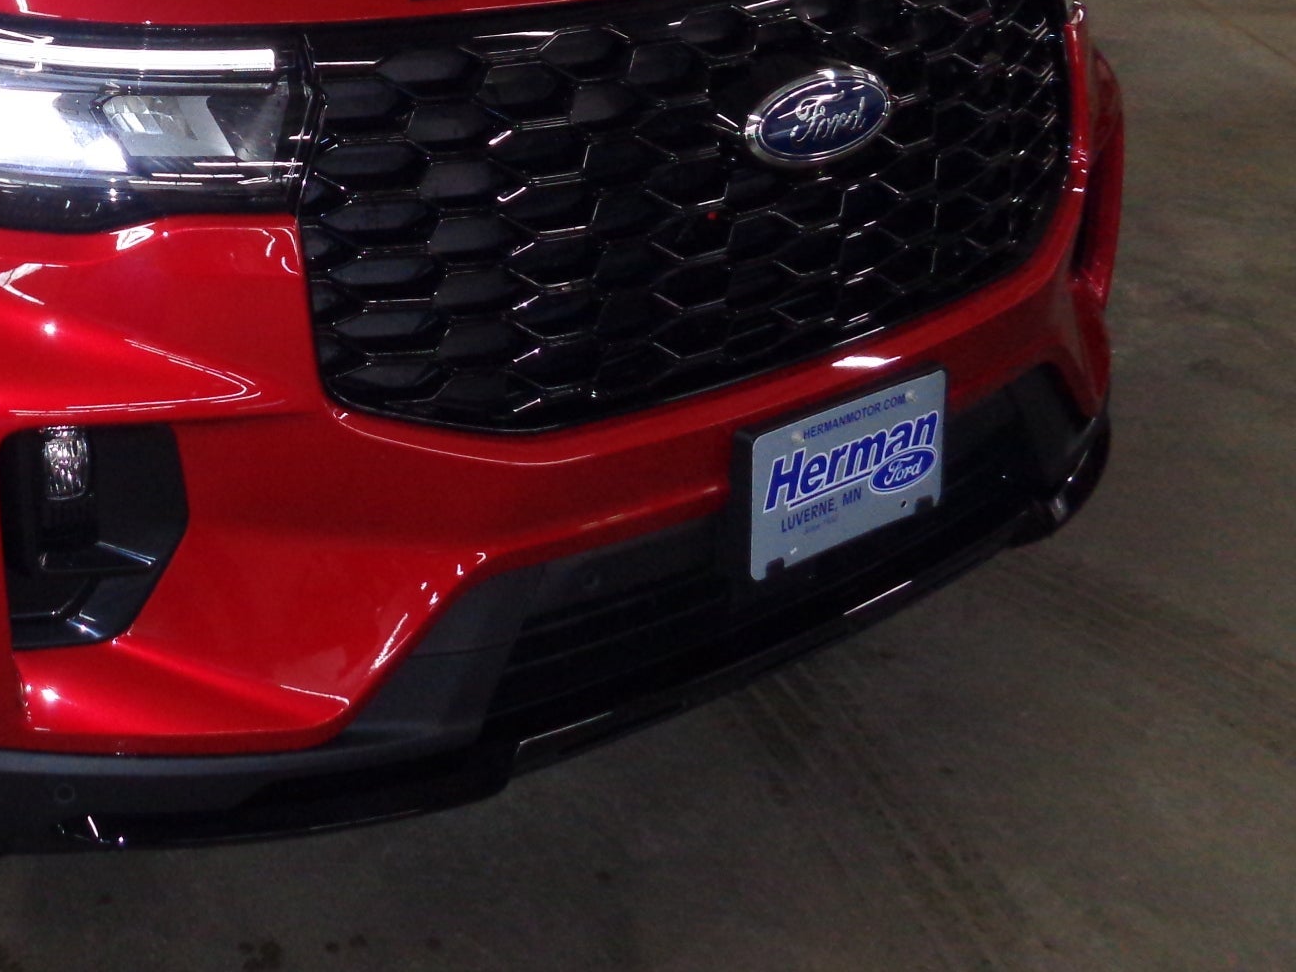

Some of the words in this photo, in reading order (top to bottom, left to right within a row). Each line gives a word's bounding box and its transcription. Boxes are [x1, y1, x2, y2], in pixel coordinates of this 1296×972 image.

[790, 90, 866, 142] Ford
[763, 411, 938, 513] Herman
[884, 458, 922, 485] Ford
[781, 497, 838, 533] LUVERNE,
[842, 487, 862, 506] MN
